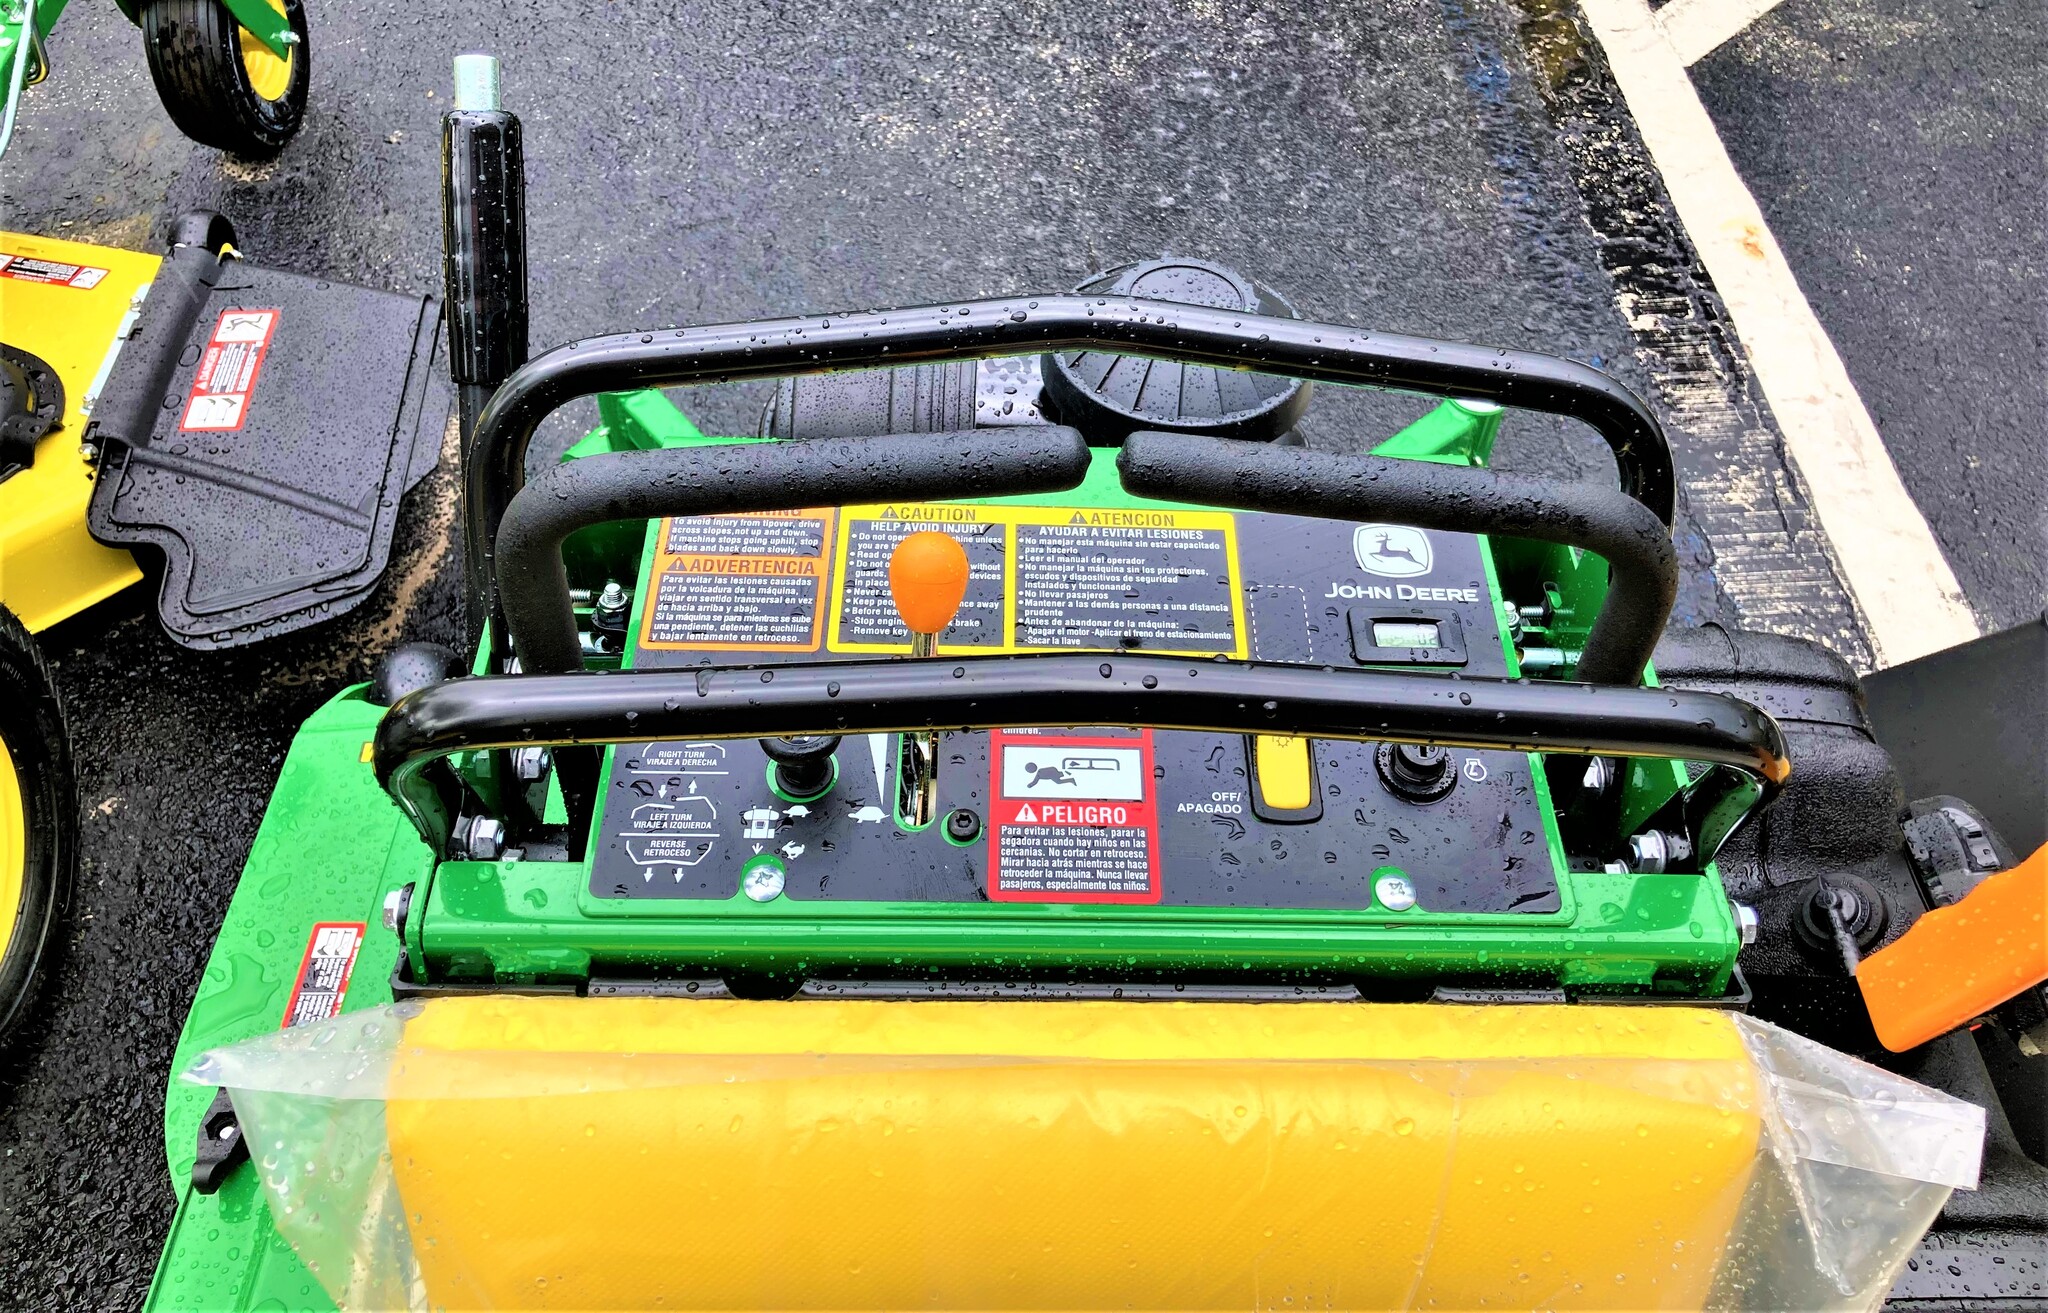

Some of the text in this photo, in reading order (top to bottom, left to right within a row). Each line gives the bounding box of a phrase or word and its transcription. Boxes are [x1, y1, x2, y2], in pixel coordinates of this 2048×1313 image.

[900, 508, 976, 520] CAUTION
[1090, 512, 1175, 526] ATENCION
[712, 518, 738, 527] injury
[762, 519, 795, 528] tipover,
[871, 522, 985, 533] HELP AVOID INJURY
[859, 532, 1002, 544] Do not unless
[1039, 527, 1204, 539] AYUDAR A EVITAR LESIONES
[679, 535, 716, 543] machine
[718, 536, 742, 545] stops
[743, 537, 768, 545] going
[770, 537, 797, 546] uphill,
[800, 538, 818, 546] stop
[1039, 538, 1074, 547] manejar
[1097, 540, 1133, 548] máquina
[1174, 542, 1220, 551] capacitado
[767, 546, 798, 554] slowly.
[856, 550, 879, 559] Read
[856, 560, 868, 568] Do
[870, 560, 883, 568] not
[970, 563, 1001, 571] without
[1057, 555, 1089, 563] manual
[1107, 557, 1145, 566] operador
[690, 560, 815, 574] ADVERTENCIA
[662, 575, 683, 583] Para
[714, 576, 728, 584] las
[969, 571, 1002, 580] devices
[1024, 572, 1059, 580] escudos
[1070, 573, 1120, 582] dispositivos
[1123, 574, 1134, 582] de
[1136, 575, 1178, 584] seguridad
[854, 578, 889, 587] in place
[853, 587, 880, 596] Never
[1066, 591, 1109, 600] pasajeros
[1324, 583, 1479, 602] JOHN DEERE
[852, 597, 875, 607] Keep
[976, 601, 1000, 609] away
[852, 606, 881, 615] Before
[1024, 609, 1063, 618] prudente
[851, 616, 875, 626] -Stop
[955, 619, 980, 627] brake
[1138, 621, 1179, 630] máquina:
[671, 623, 717, 632] pendiente,
[850, 626, 909, 637] -Remove key
[660, 633, 684, 641] bajar
[1061, 637, 1081, 645] llave
[1211, 792, 1241, 803] OFF/
[1177, 803, 1242, 814] APAGADO
[1042, 806, 1127, 824] PELIGRO
[1001, 826, 1146, 839] Para evitar las lesiones, parar la
[1001, 837, 1040, 848] segadora
[1043, 837, 1074, 846] cuando
[1076, 838, 1091, 849] hay
[1093, 838, 1120, 847] niños
[1133, 838, 1146, 847] las
[1048, 847, 1060, 856] No
[1062, 848, 1088, 857] cortar
[1103, 849, 1146, 858] retroceso.
[1001, 857, 1024, 866] Mirar
[1026, 858, 1049, 867] hacia
[1051, 858, 1073, 867] atrás
[1075, 859, 1112, 868] mientras
[1127, 860, 1148, 869] hace
[1000, 868, 1148, 880] retroceder la máquina. Nunca llevar
[1000, 879, 1149, 891] pasajeros, especialmente los niños.
